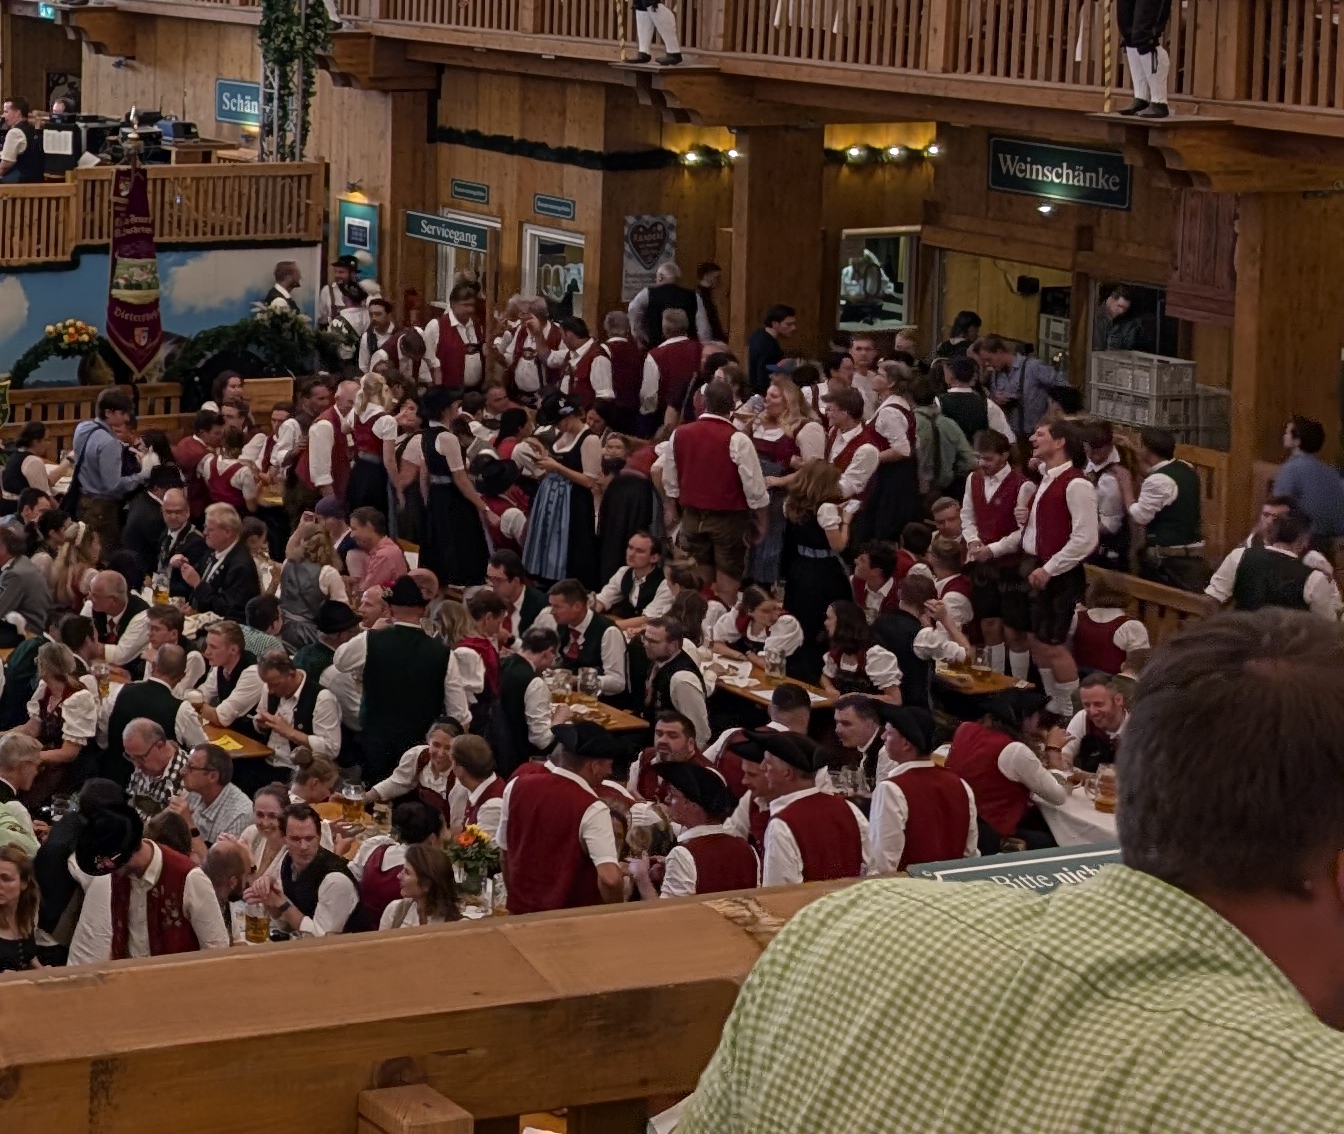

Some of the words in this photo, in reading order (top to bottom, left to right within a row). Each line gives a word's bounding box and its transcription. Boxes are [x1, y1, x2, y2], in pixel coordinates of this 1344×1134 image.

[221, 92, 260, 115] Schän
[998, 153, 1120, 191] Weinschänke
[420, 219, 478, 247] Servicegang
[991, 873, 1054, 889] Bitte
[1053, 864, 1103, 885] nich
